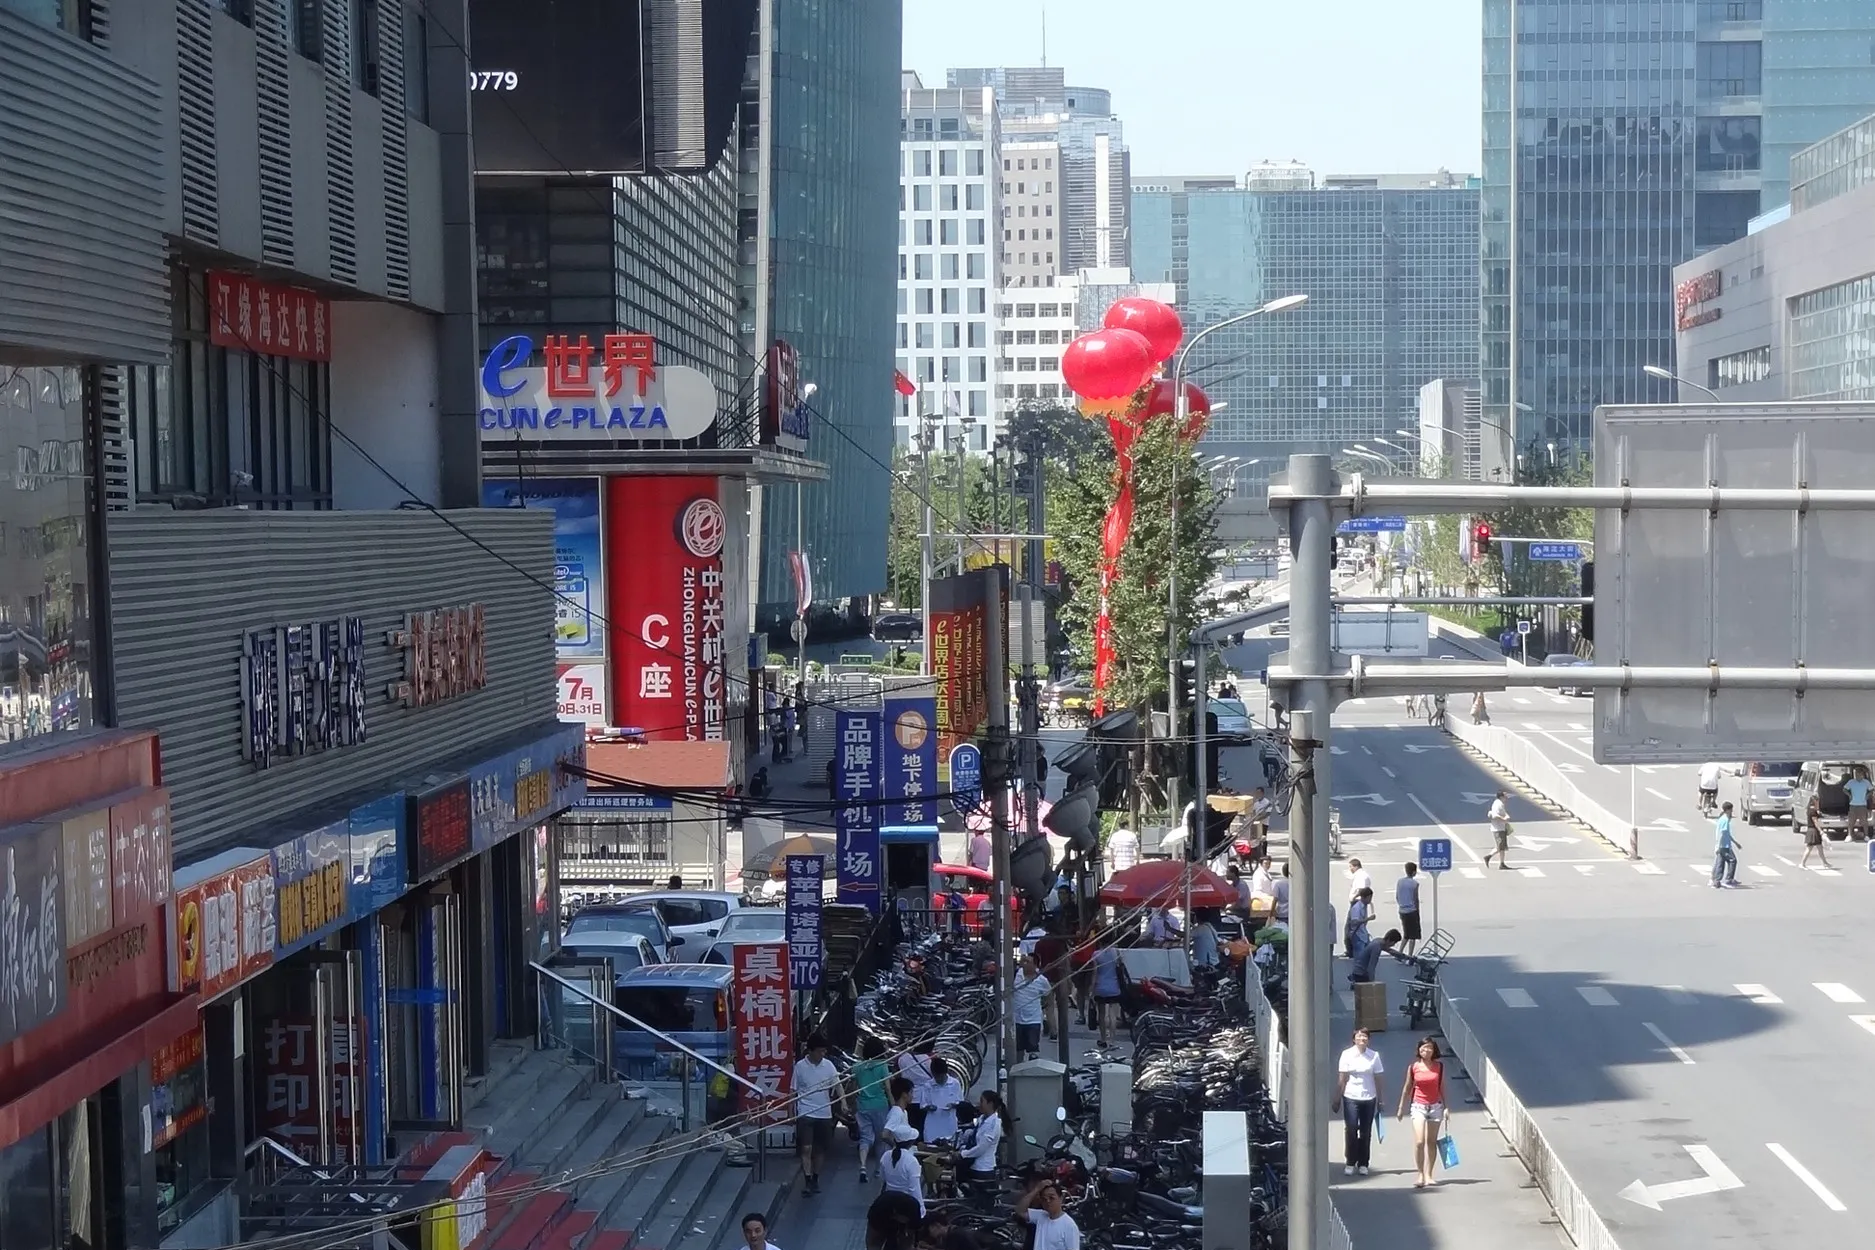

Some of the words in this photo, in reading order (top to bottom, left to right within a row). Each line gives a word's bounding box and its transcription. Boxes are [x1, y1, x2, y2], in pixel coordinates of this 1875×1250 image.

[543, 406, 668, 430] e-PLAZA
[683, 566, 697, 698] ZHONGGUANCUN
[842, 717, 873, 878] 品牌手机广场
